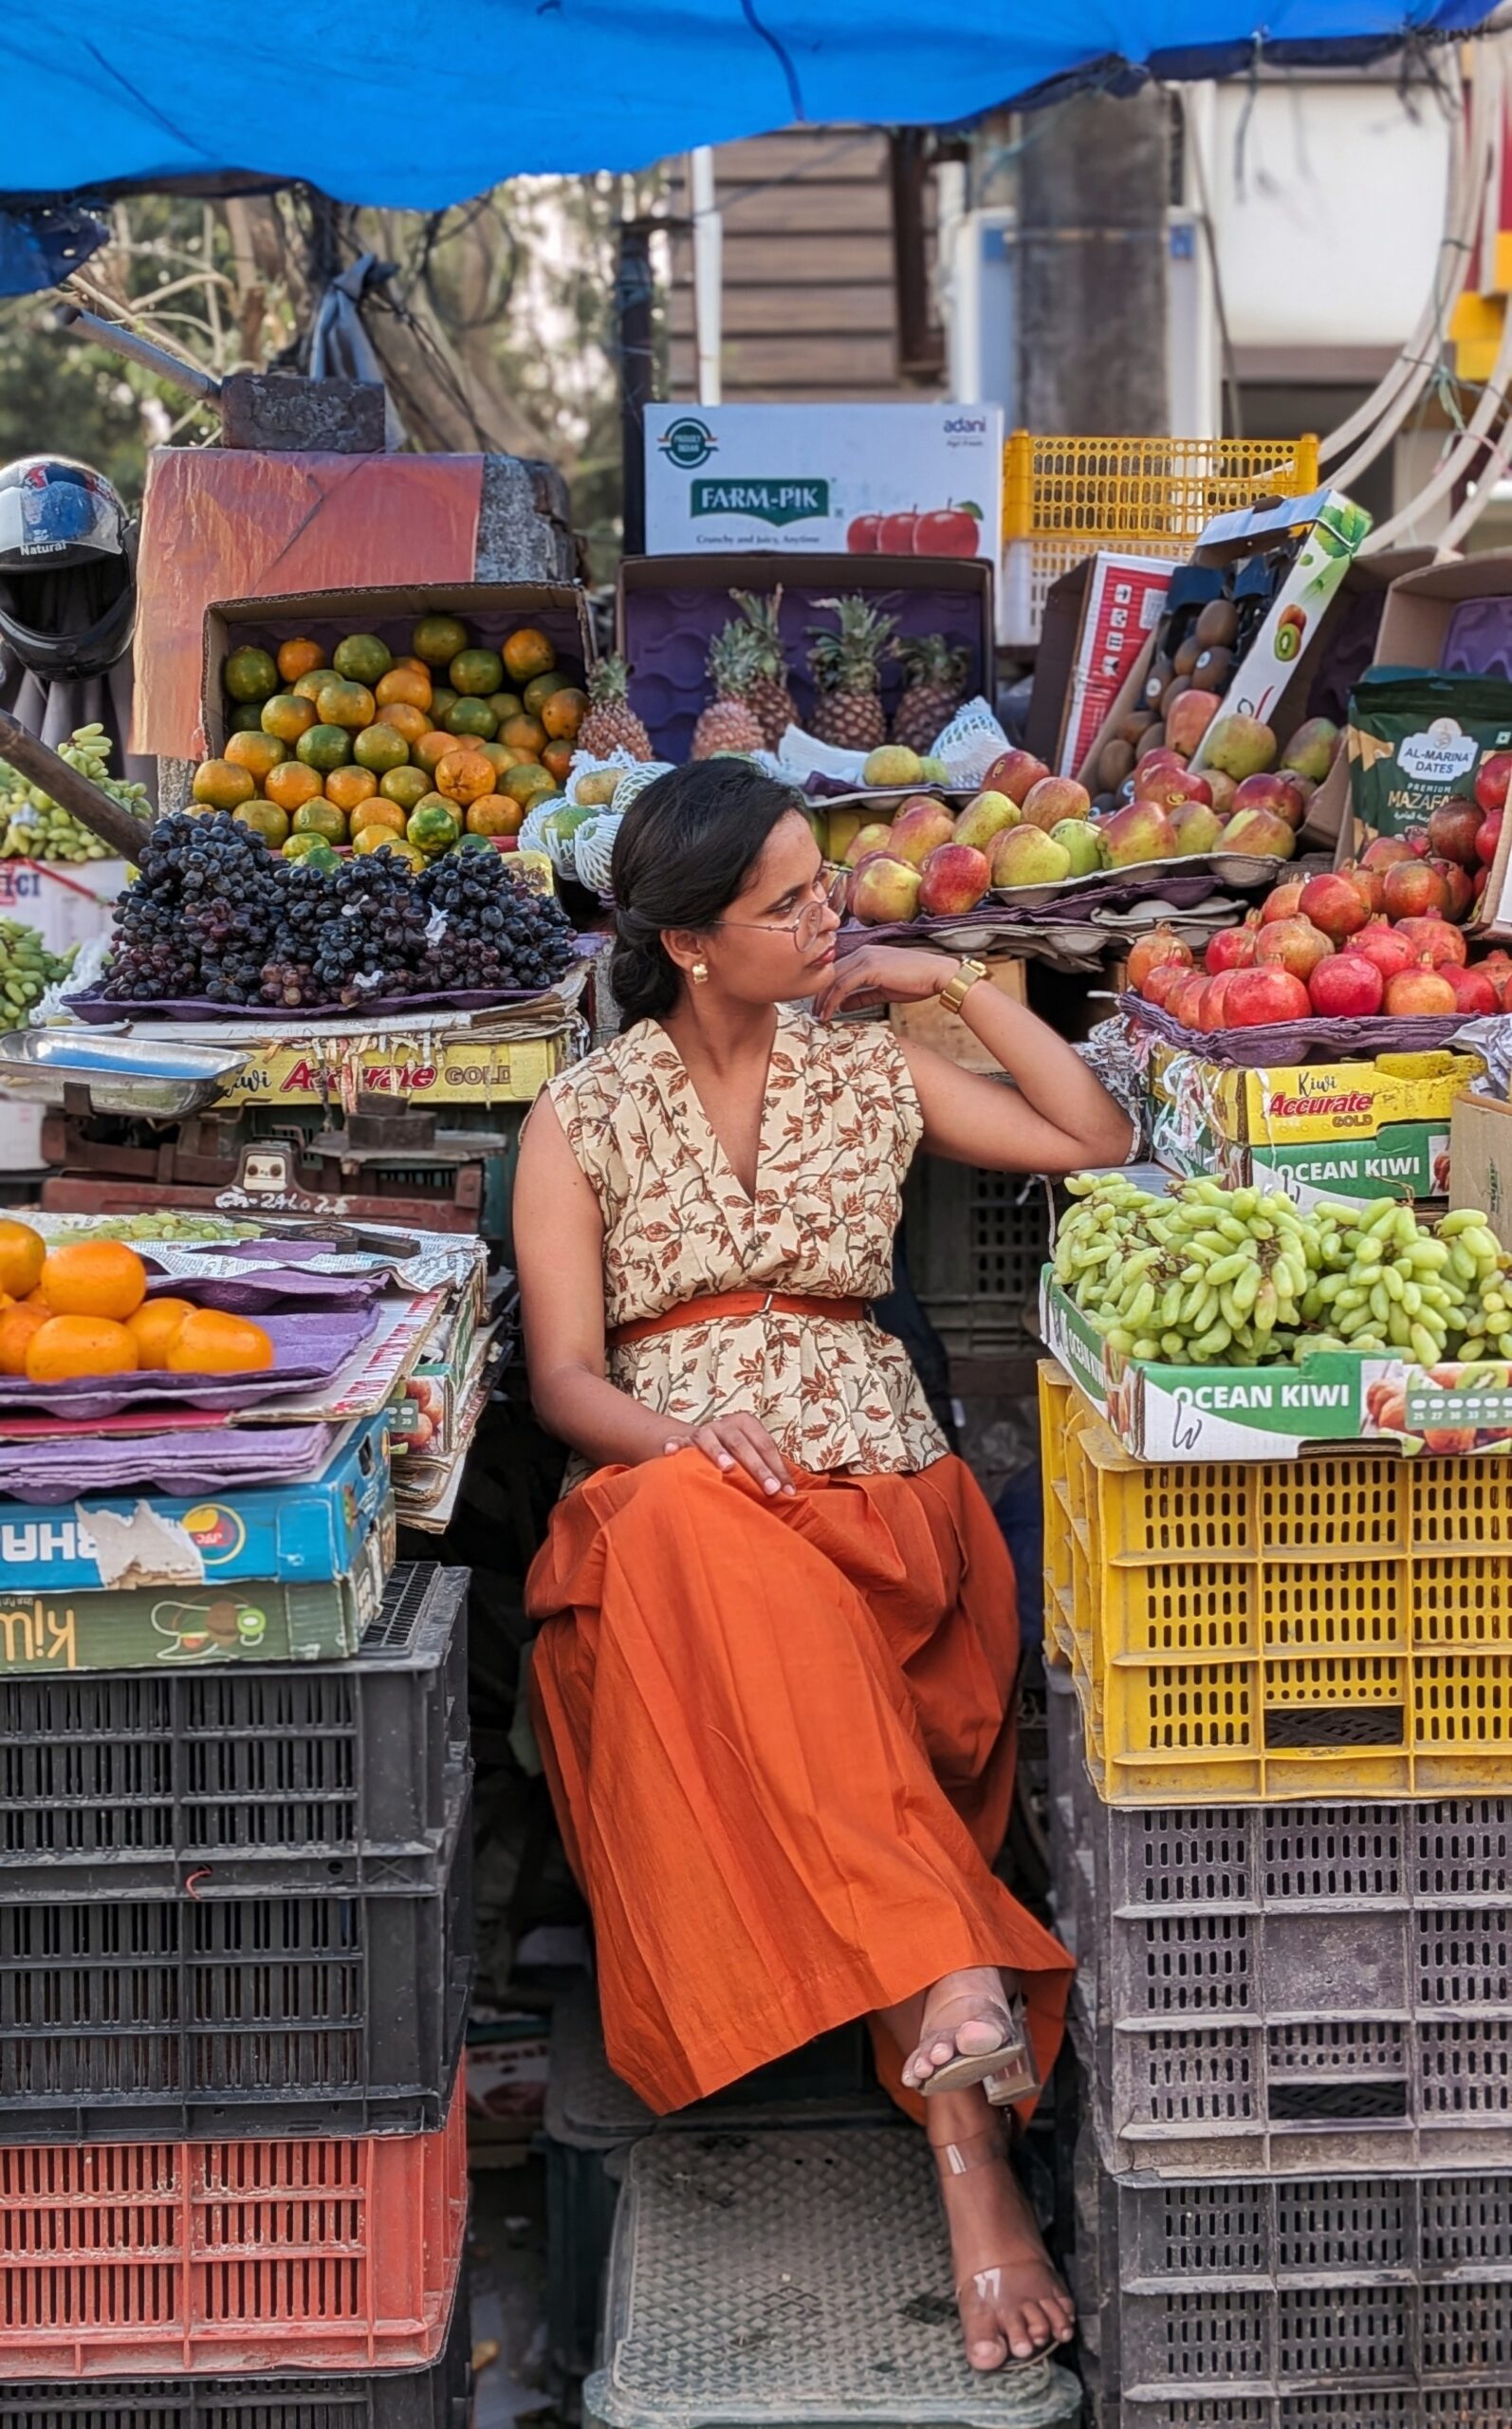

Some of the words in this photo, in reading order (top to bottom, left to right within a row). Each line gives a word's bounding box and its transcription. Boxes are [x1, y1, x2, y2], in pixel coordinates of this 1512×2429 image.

[944, 416, 986, 434] adani
[701, 487, 819, 509] FARM-PIK
[20, 540, 67, 556] Natural
[1405, 748, 1469, 762] AL-MARINA
[1415, 761, 1454, 774] DATES
[1408, 782, 1452, 793] PREMIUM
[1298, 1072, 1337, 1097] Kiwi
[1262, 1091, 1374, 1118] Accurate
[1332, 1114, 1374, 1127] GOLD
[1278, 1160, 1358, 1182] OCEAN
[1365, 1156, 1420, 1177] KIWI
[1173, 1385, 1272, 1409] OCEAN
[1281, 1383, 1350, 1407] KIWI
